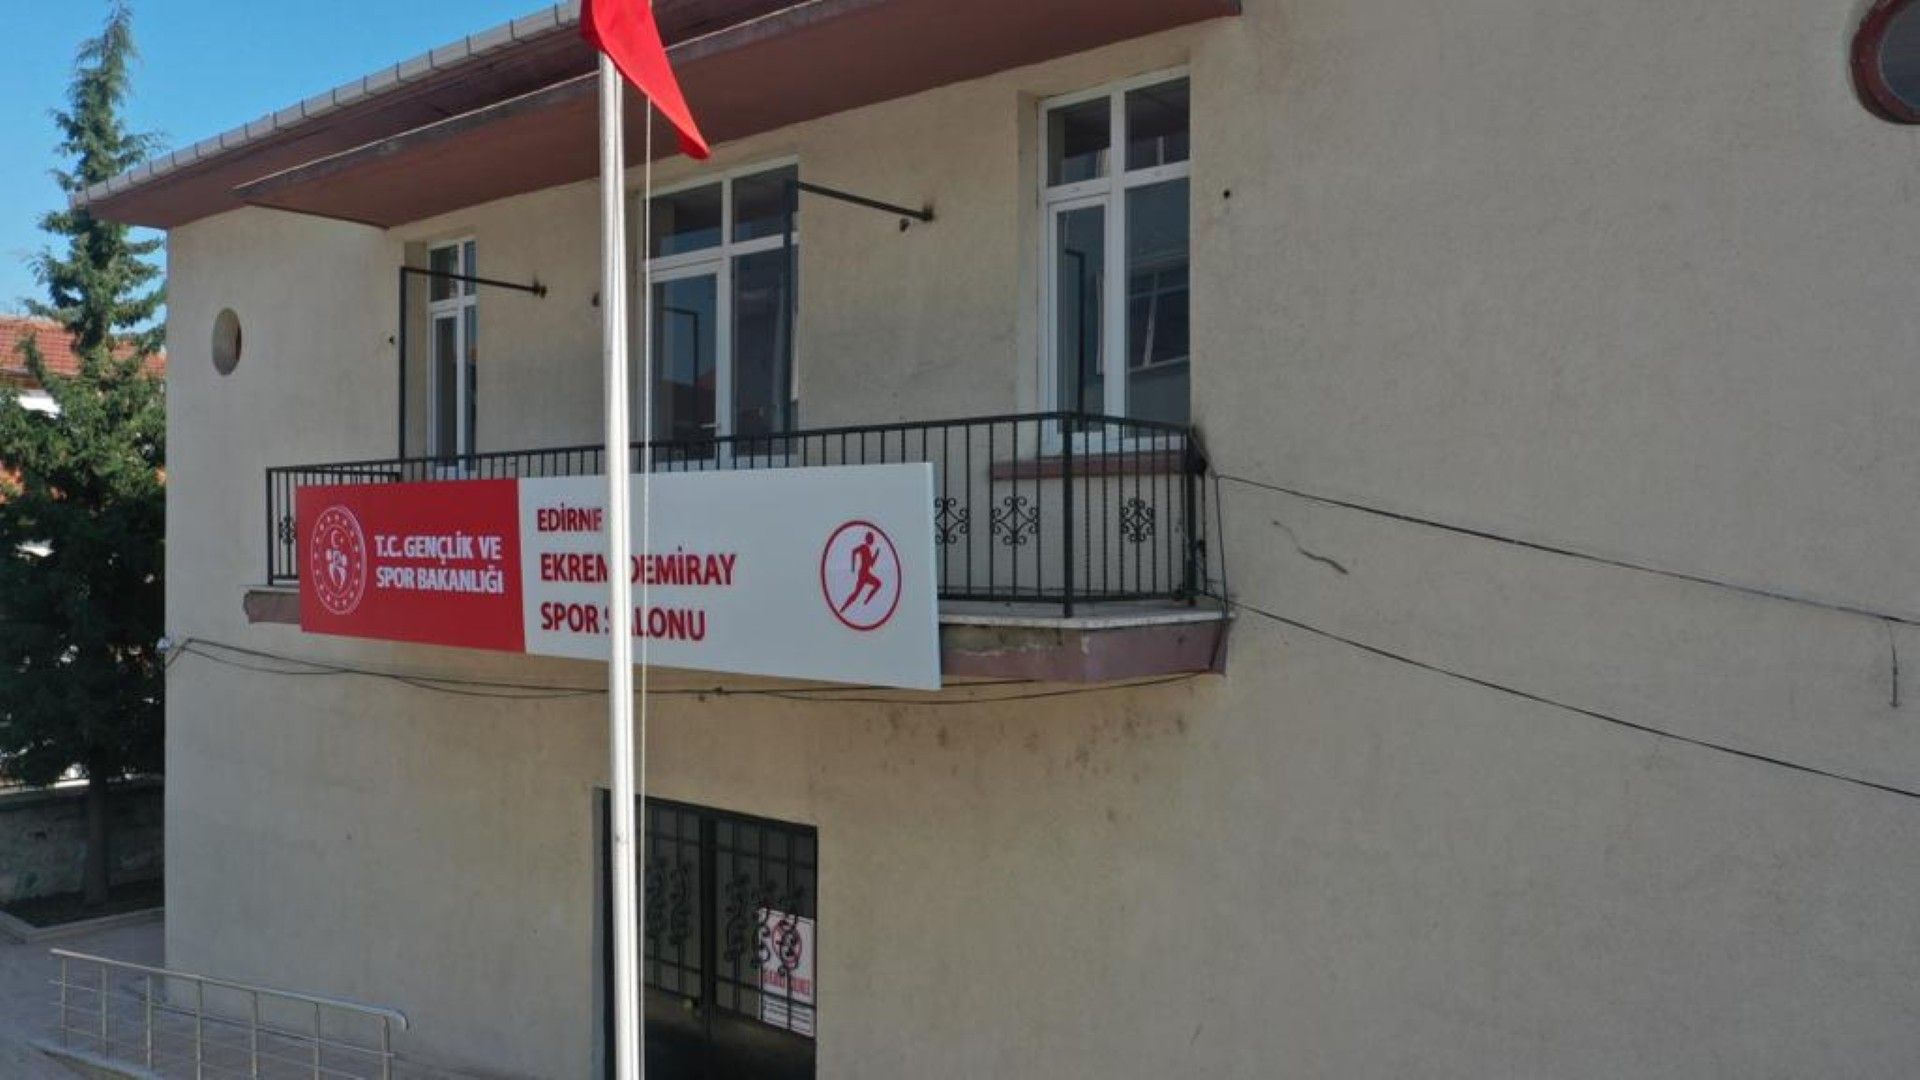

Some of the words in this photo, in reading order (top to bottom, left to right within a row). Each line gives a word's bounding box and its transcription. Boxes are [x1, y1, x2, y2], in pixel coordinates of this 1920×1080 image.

[537, 502, 602, 533] EDİRNE
[374, 535, 400, 558] T.C.
[403, 530, 473, 566] GENÇLİK
[477, 536, 503, 560] VE
[540, 553, 608, 583] EKREM
[630, 545, 737, 586] DEMİRAY
[375, 566, 415, 588] SPOR
[416, 565, 504, 594] BAKANLIĞI
[541, 602, 600, 634] SPOR
[604, 606, 706, 642] LONU
